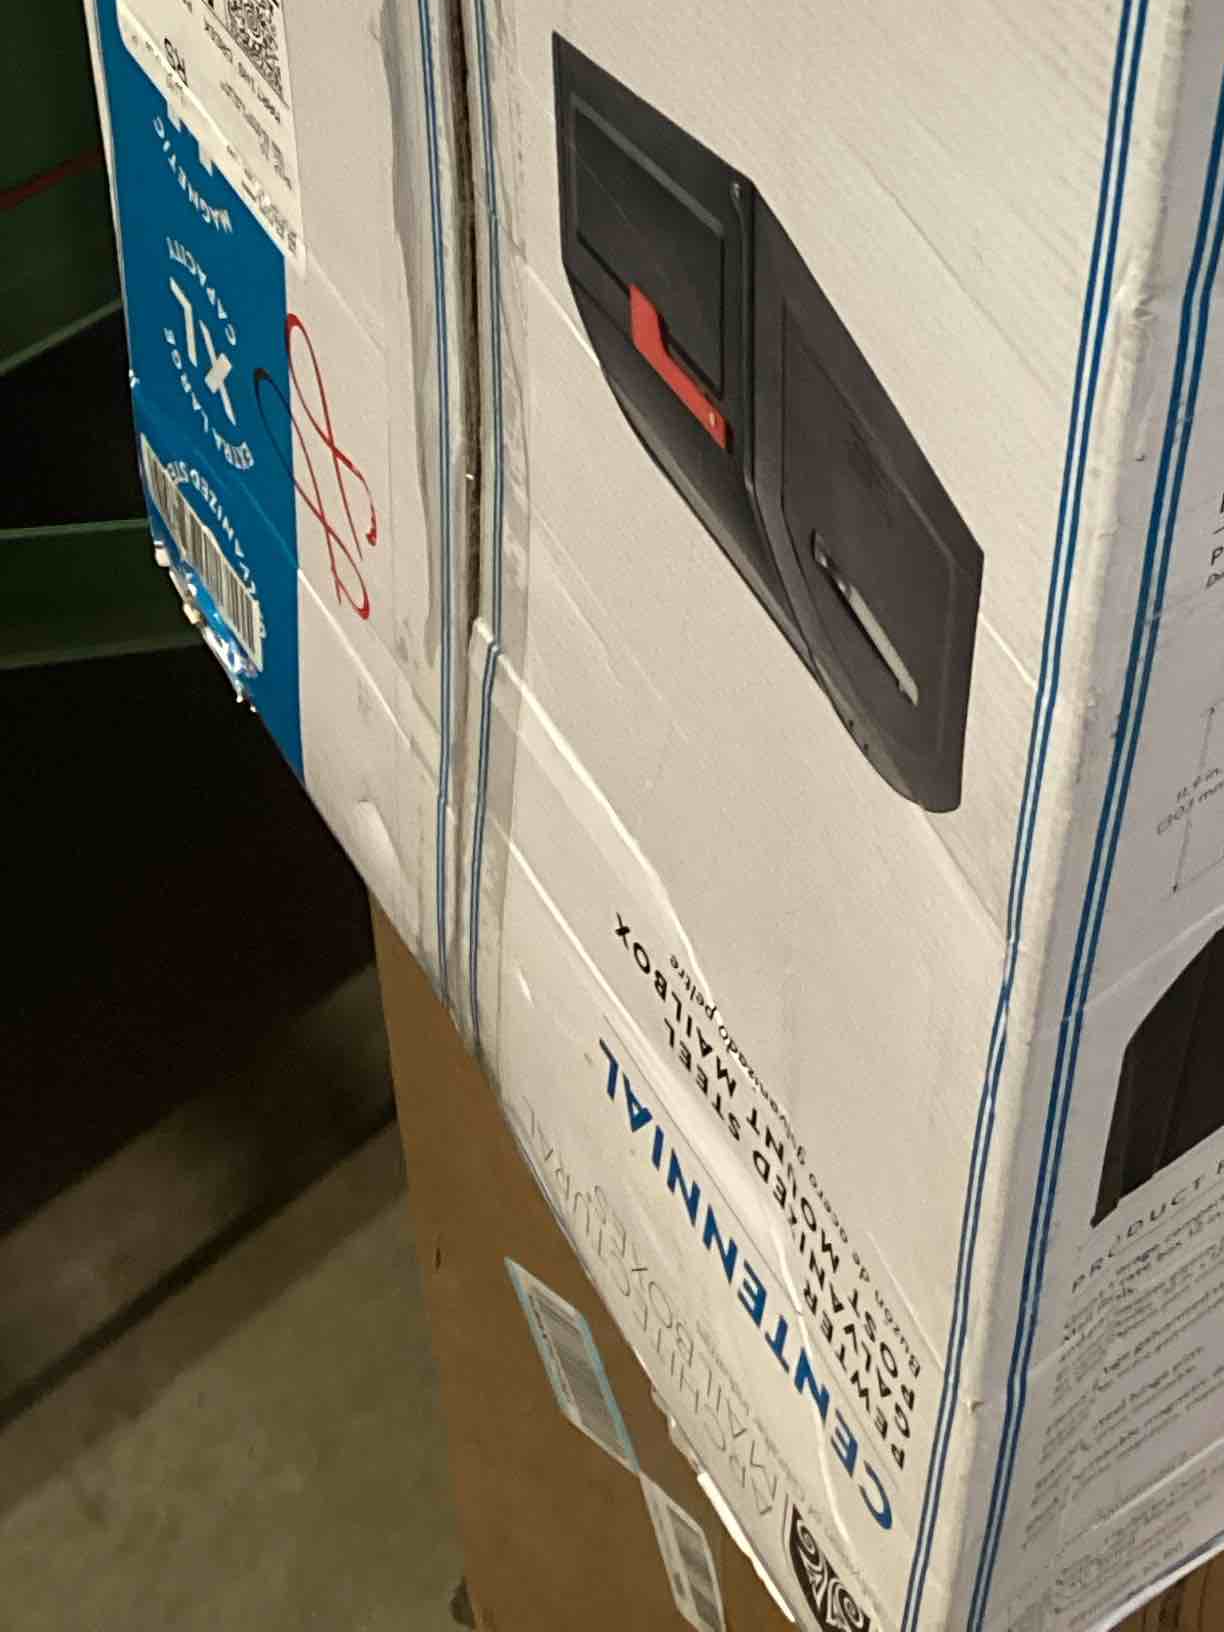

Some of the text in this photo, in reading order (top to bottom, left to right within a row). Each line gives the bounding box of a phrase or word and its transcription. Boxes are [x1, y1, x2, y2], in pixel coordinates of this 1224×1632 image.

[614, 911, 737, 1098] MAILBOX
[664, 1017, 741, 1142] STEEL
[747, 1107, 840, 1274] MOUNT
[1071, 1173, 1206, 1294] PRODUCT
[599, 1037, 893, 1531] CENTENNIAL
[848, 1288, 915, 1411] POST
[804, 1279, 906, 1470] PEWTER
